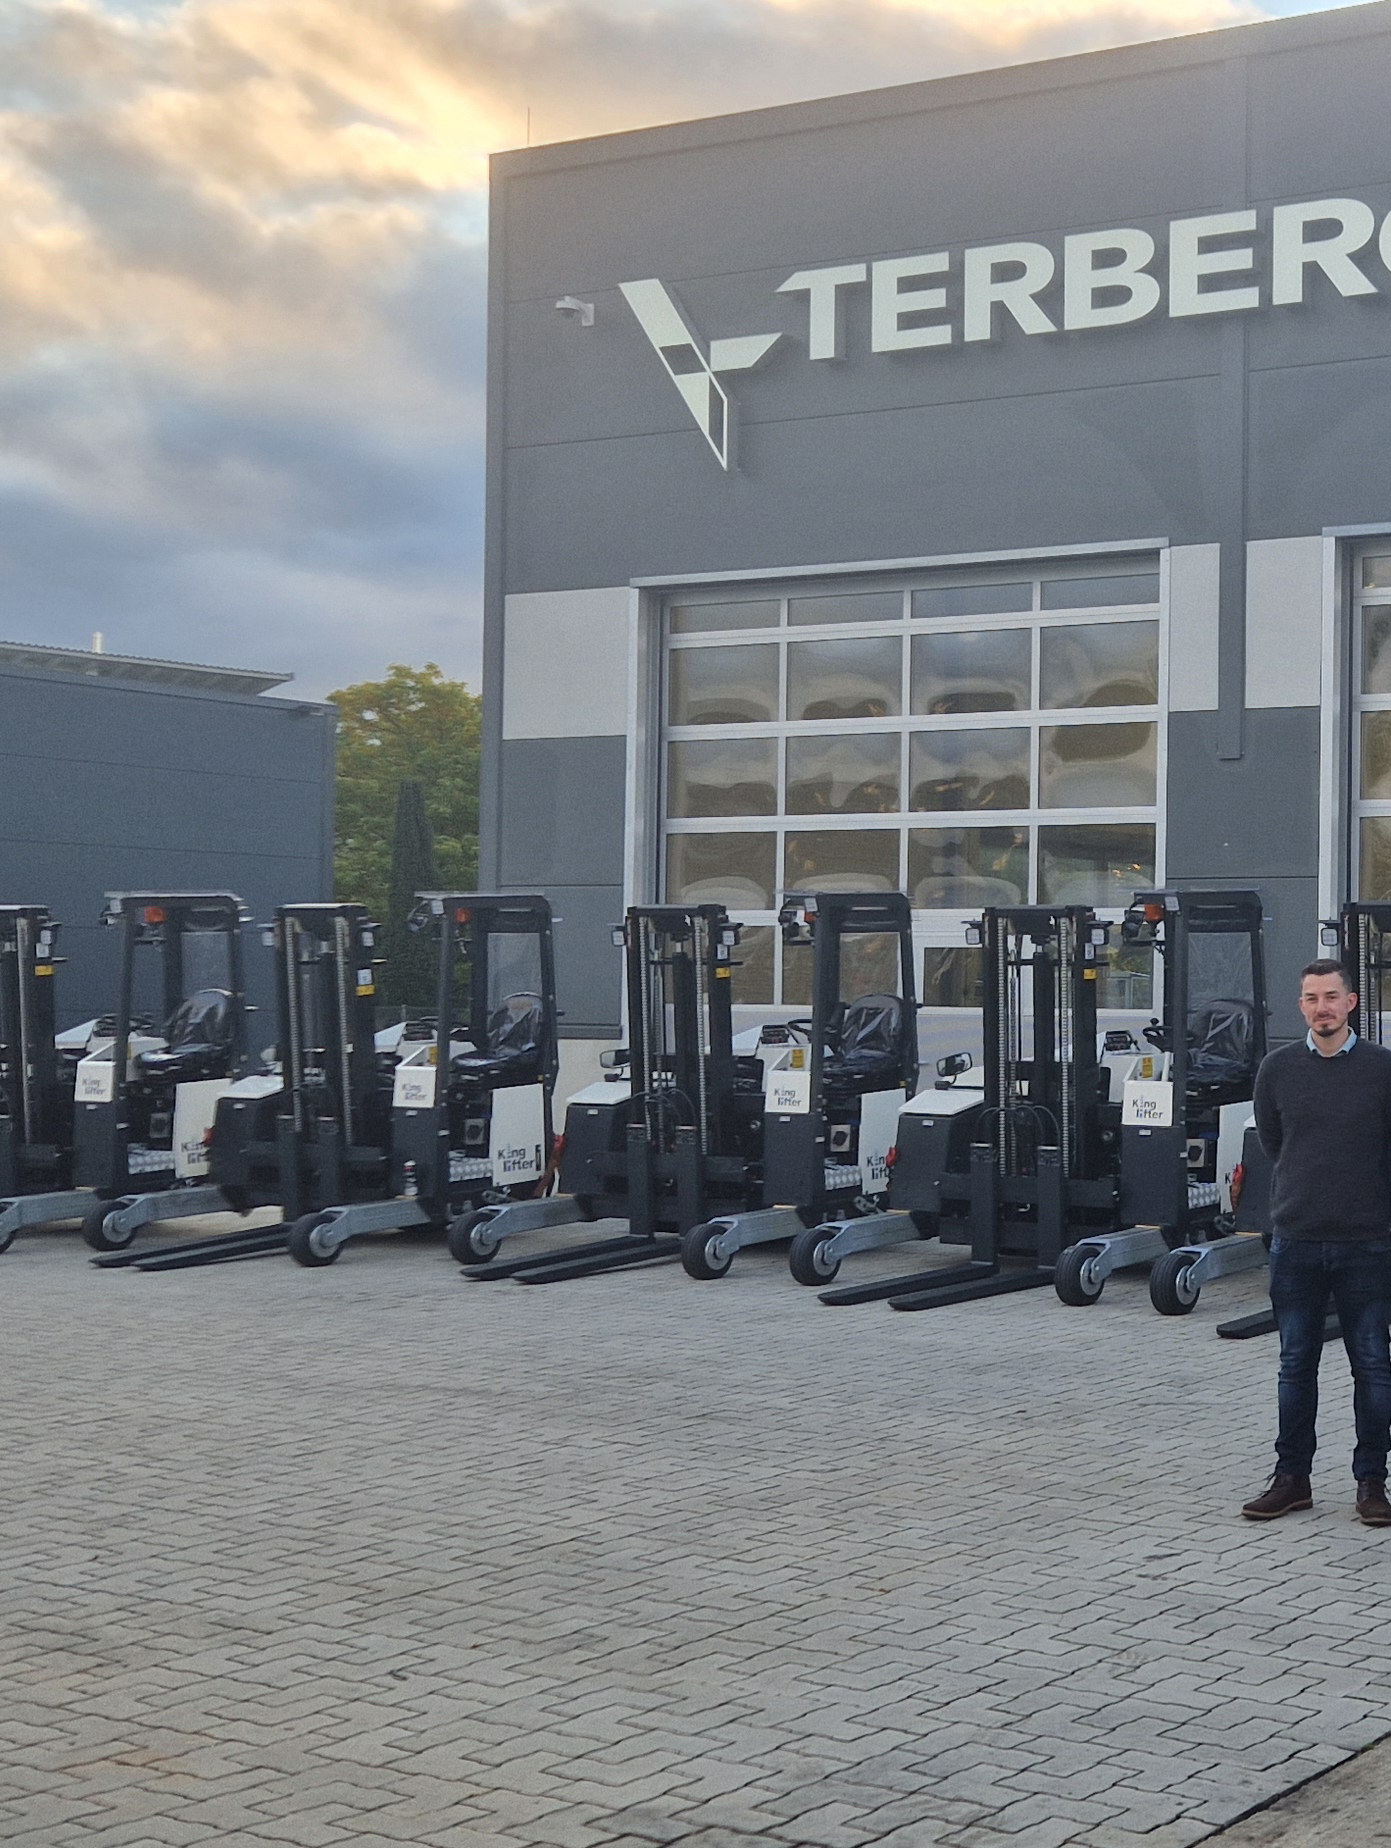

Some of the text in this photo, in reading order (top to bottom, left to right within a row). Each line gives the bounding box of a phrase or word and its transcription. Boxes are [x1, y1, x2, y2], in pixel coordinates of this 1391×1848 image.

[774, 1086, 796, 1098] King
[777, 1097, 802, 1107] lifter
[1132, 1095, 1157, 1109] King
[1136, 1109, 1164, 1119] lifter
[498, 1146, 527, 1160] King
[503, 1159, 536, 1173] lifter
